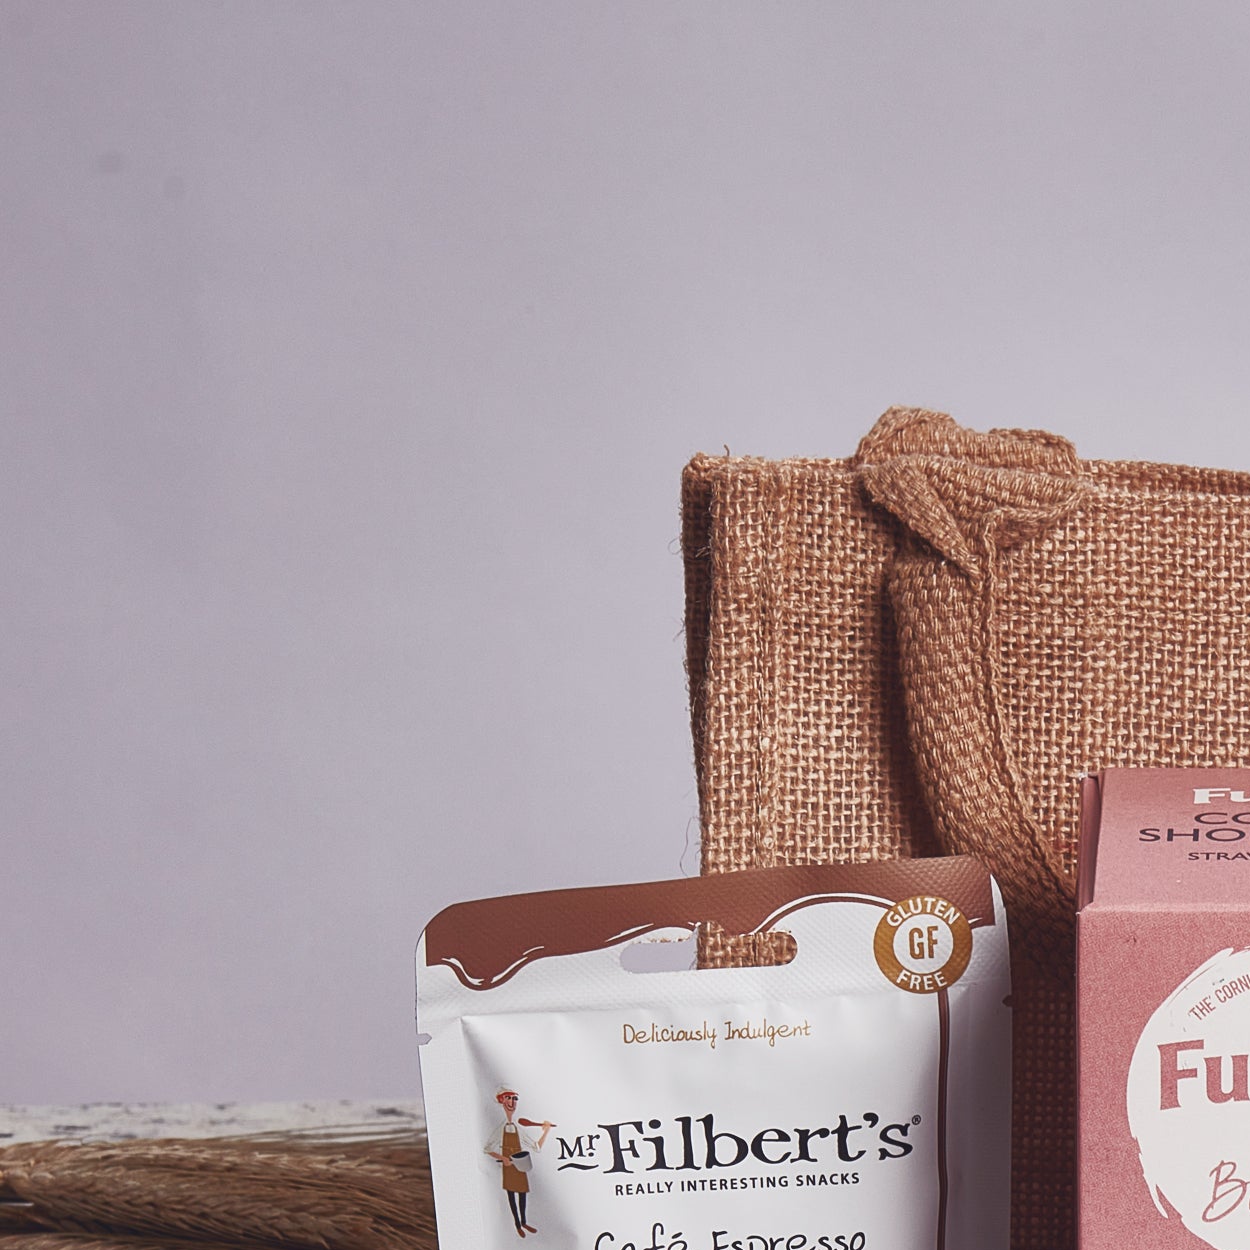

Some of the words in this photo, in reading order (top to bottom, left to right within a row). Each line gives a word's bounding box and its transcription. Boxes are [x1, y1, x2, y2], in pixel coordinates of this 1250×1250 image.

[886, 897, 960, 926] GLUTEN
[908, 926, 939, 960] GF
[896, 969, 948, 991] FREE
[622, 1021, 716, 1049] Deliciously
[724, 1018, 812, 1047] Indulgent
[615, 1181, 674, 1196] REALLY
[681, 1175, 789, 1192] INTERESTING
[796, 1172, 861, 1188] SNACKS
